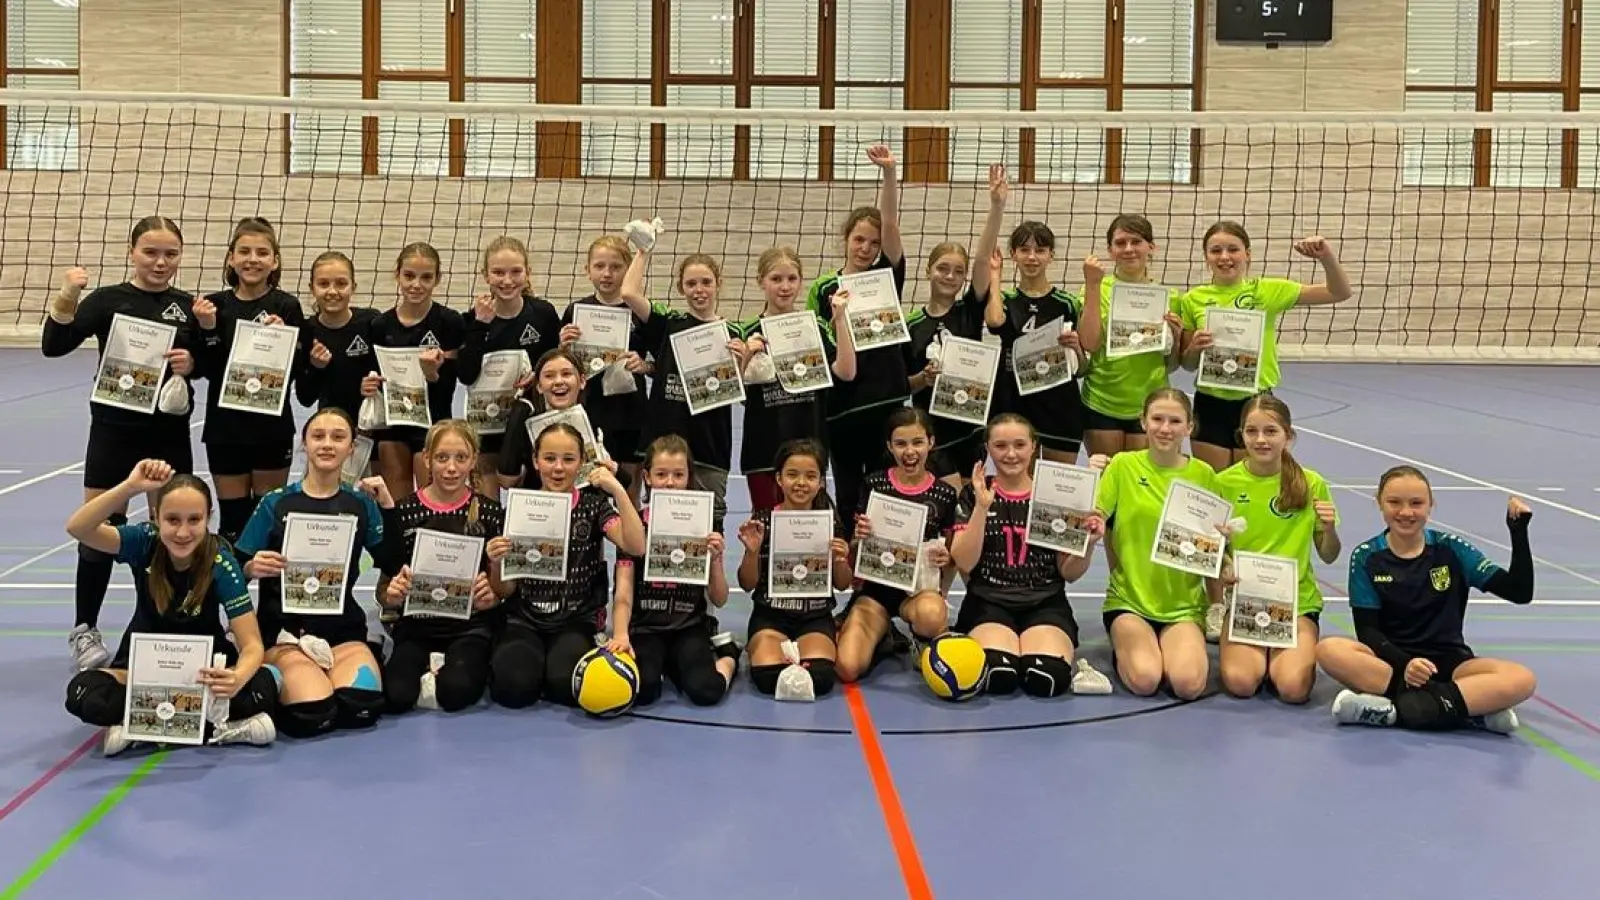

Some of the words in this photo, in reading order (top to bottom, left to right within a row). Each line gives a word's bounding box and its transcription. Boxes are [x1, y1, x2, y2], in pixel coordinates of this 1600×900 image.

[1022, 315, 1037, 333] 4
[1002, 525, 1028, 568] 17
[153, 642, 192, 654] Urkunde
